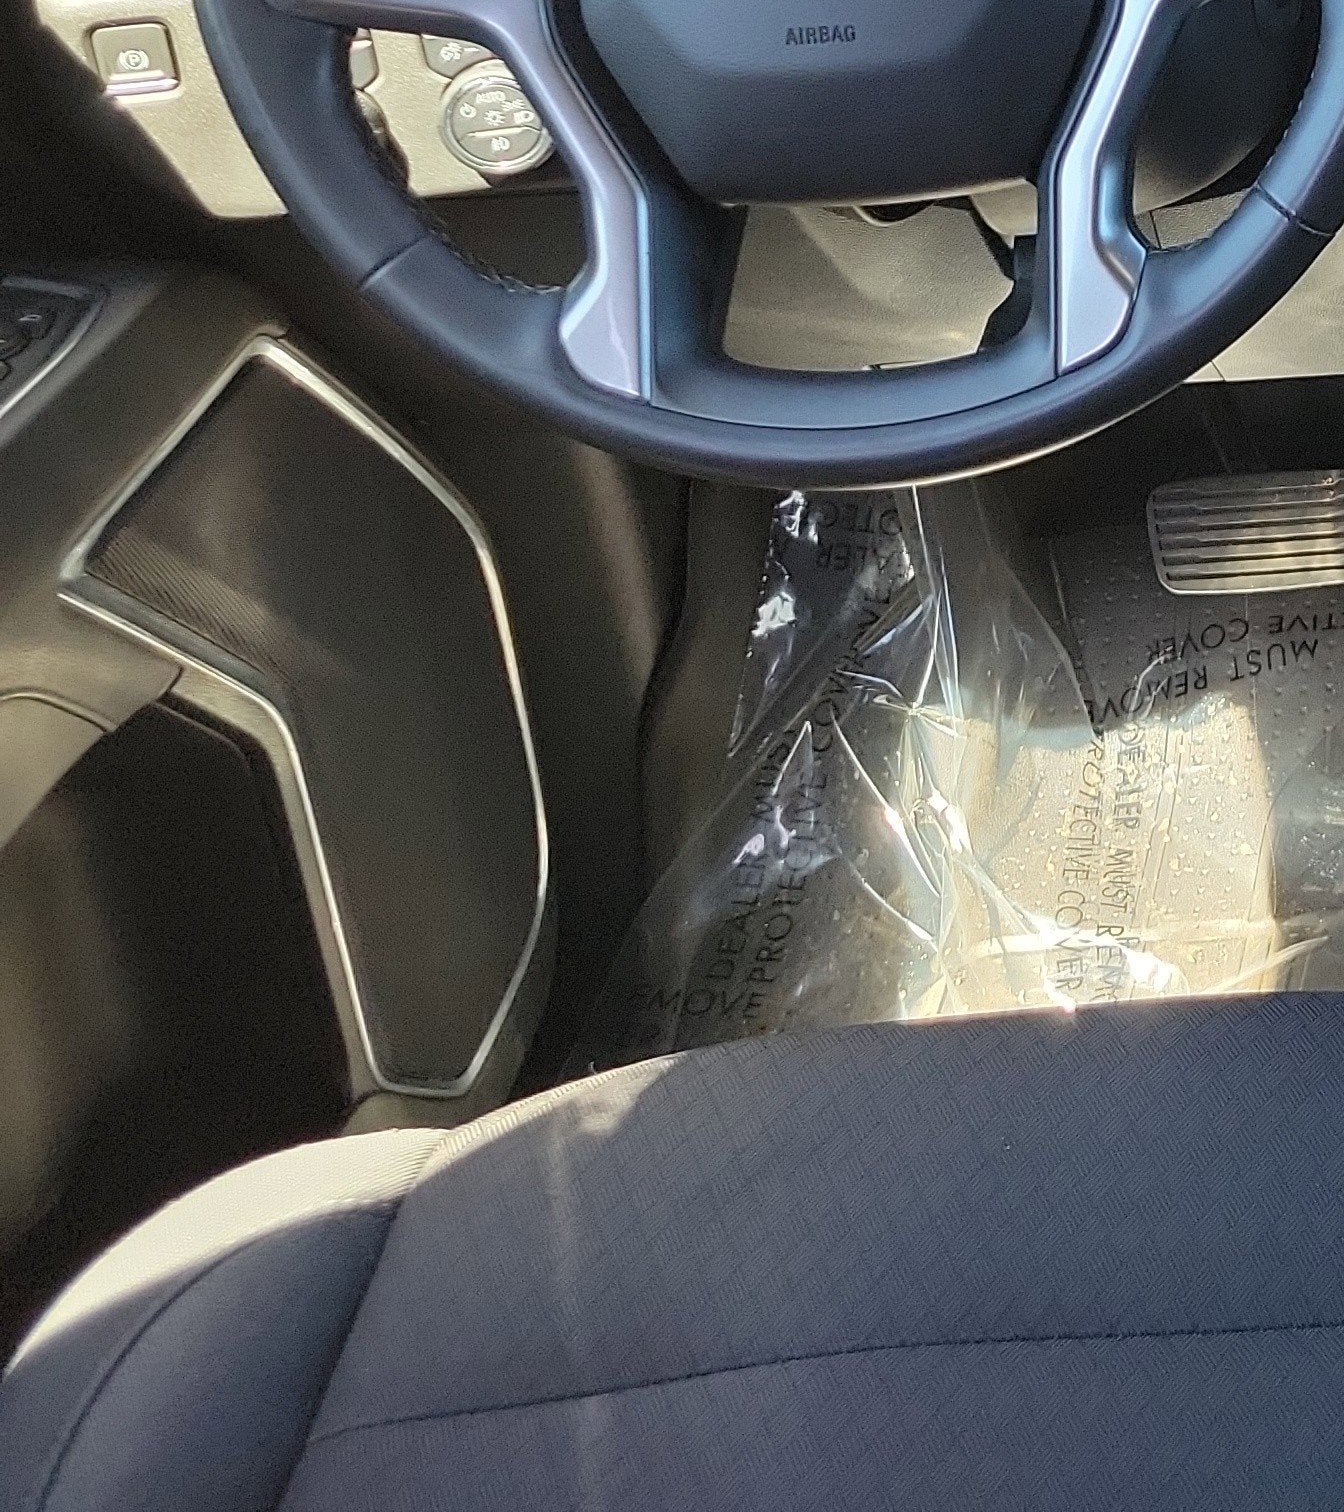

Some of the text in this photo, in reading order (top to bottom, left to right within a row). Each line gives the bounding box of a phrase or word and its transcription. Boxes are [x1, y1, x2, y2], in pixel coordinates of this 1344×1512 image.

[785, 24, 856, 45] AIRBAG
[1146, 616, 1250, 665] COVER
[1228, 638, 1319, 682] MUST
[1062, 730, 1104, 882] ROTECTIVE
[1100, 847, 1134, 914] MUST
